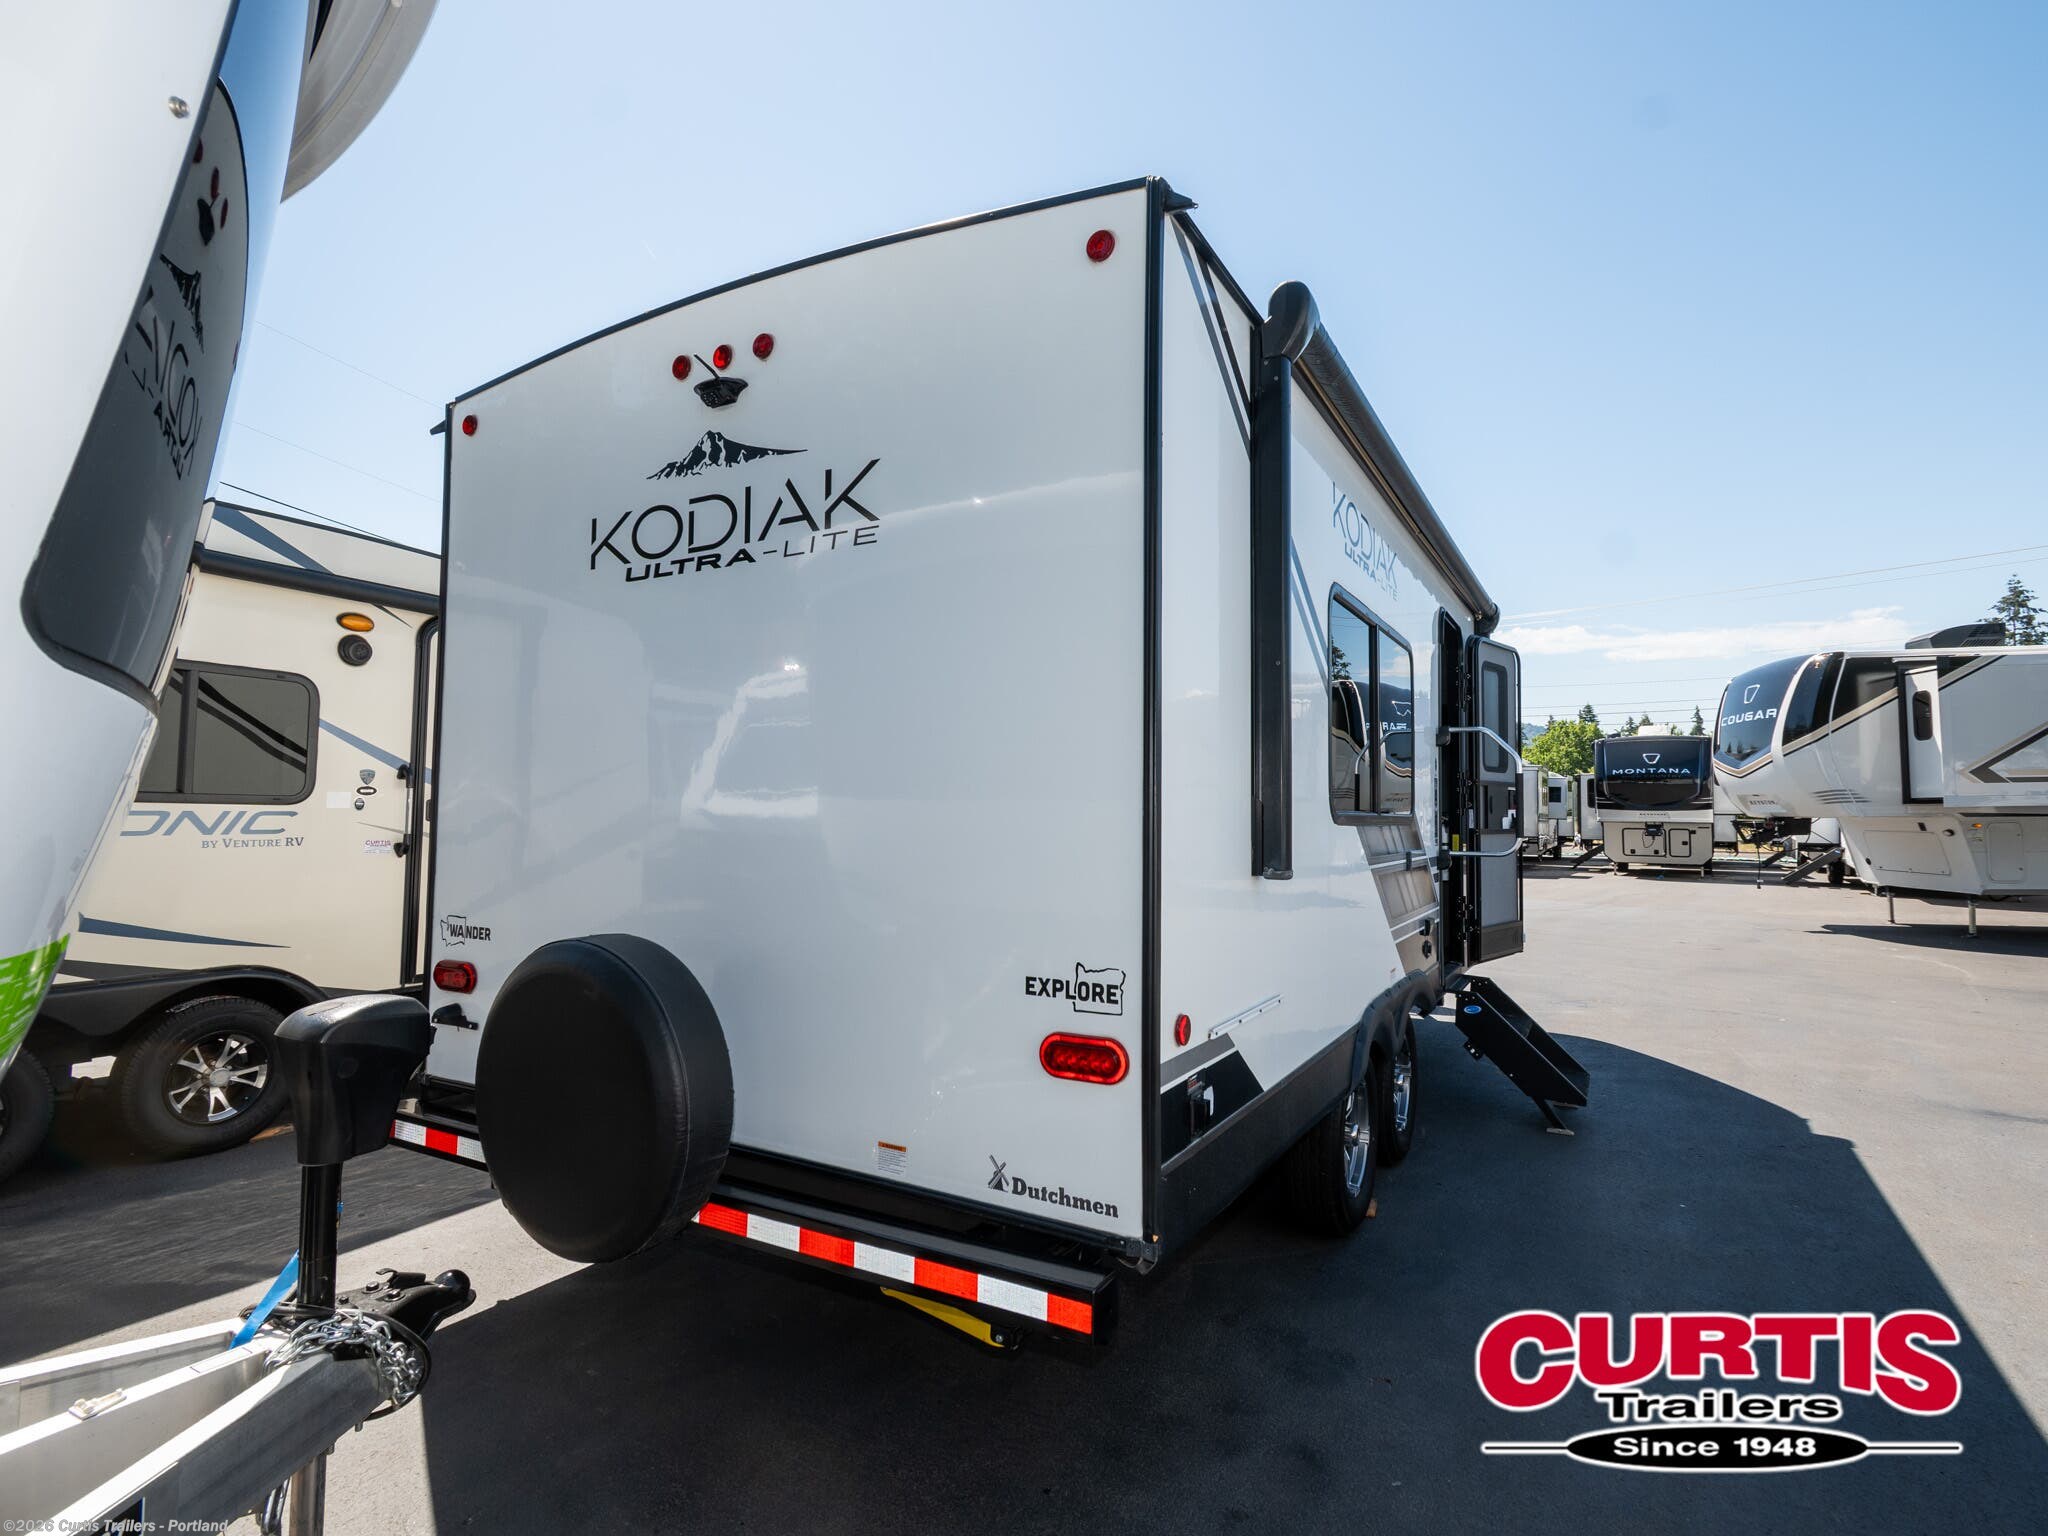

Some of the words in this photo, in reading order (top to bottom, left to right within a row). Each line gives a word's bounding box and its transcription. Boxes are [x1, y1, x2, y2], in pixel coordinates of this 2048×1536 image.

[590, 458, 881, 570] KODIAK
[1332, 481, 1398, 588] KODIAK
[625, 525, 880, 582] ULTRA-LITE
[1344, 542, 1398, 601] ULTRA-LITE
[1721, 708, 1777, 727] COUGAR
[202, 840, 218, 848] BY
[285, 837, 304, 847] RV
[450, 924, 491, 941] WANDER
[1025, 976, 1119, 1005] EXPLORE
[1012, 1177, 1119, 1218] Dutchmen
